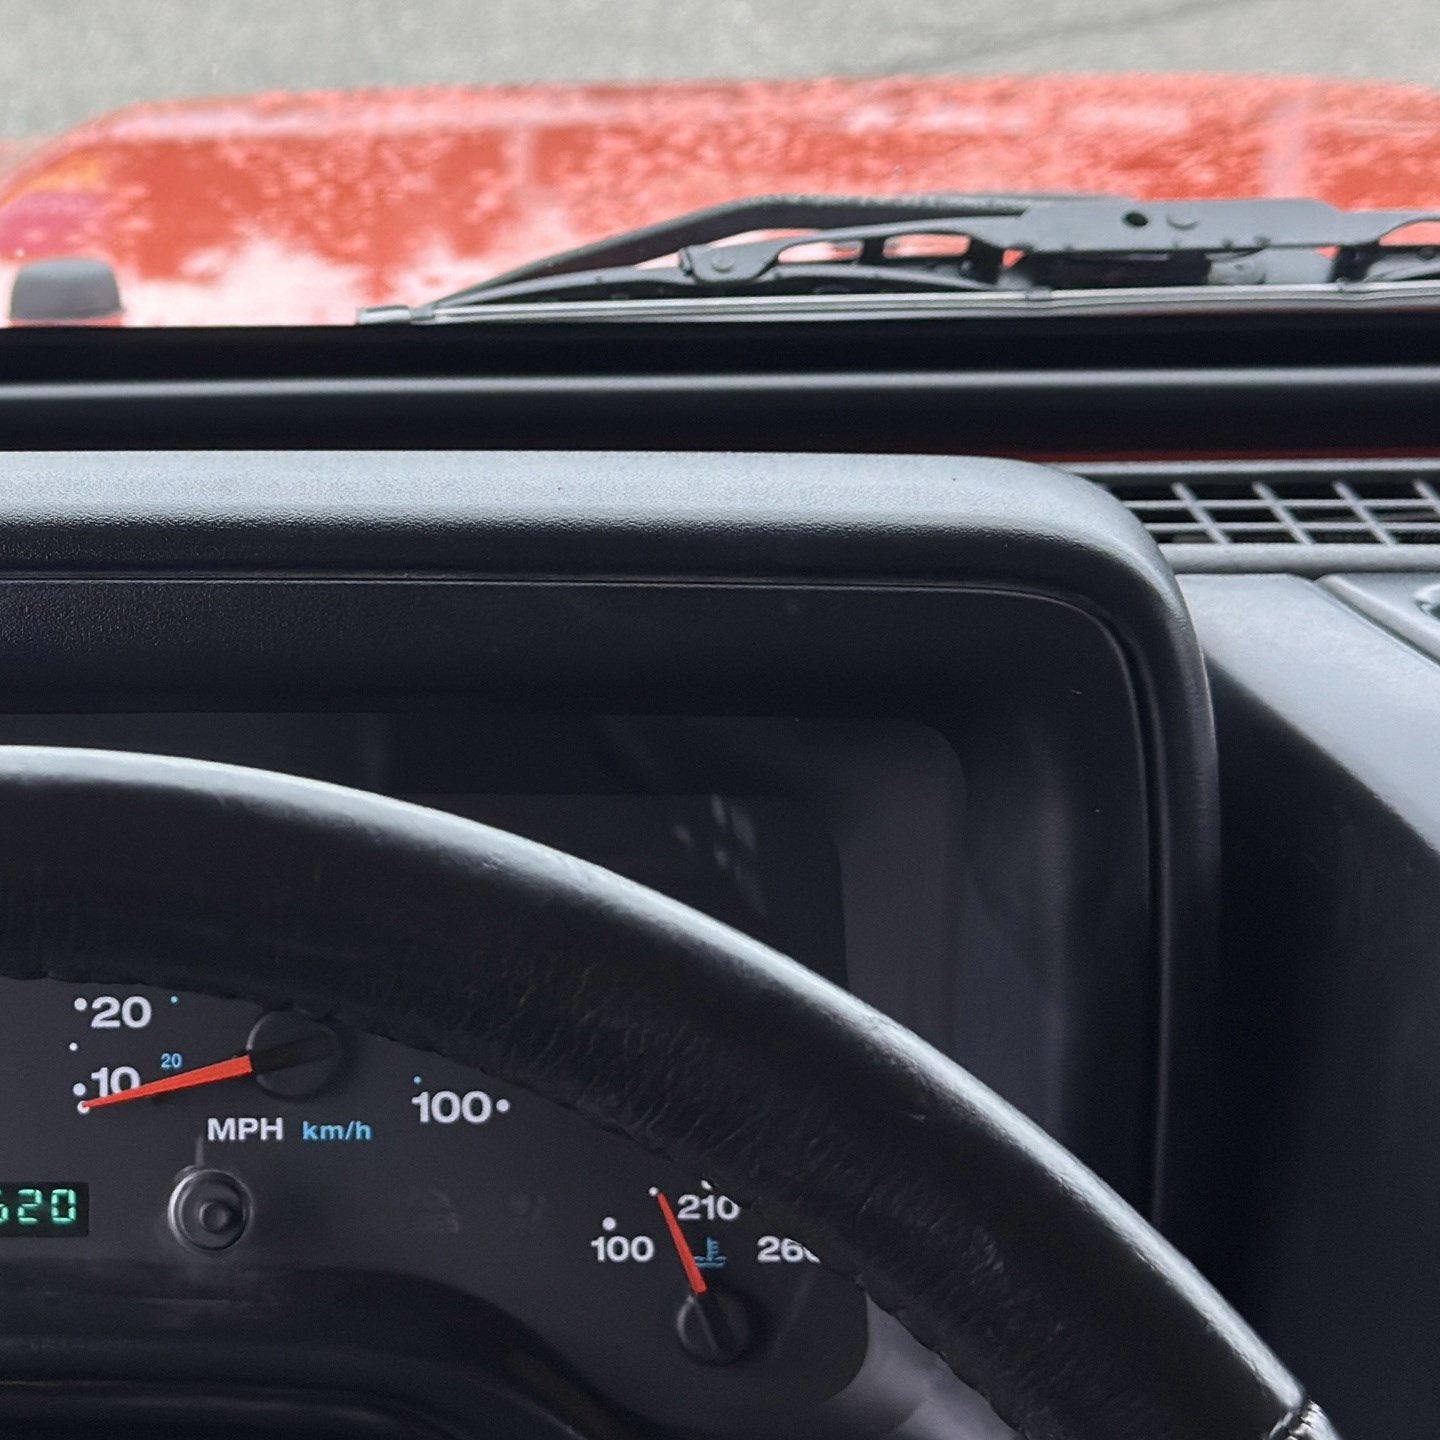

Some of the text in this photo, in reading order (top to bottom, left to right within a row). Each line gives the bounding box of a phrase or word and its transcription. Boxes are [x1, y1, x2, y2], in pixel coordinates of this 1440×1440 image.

[90, 995, 152, 1029] 20
[160, 1052, 183, 1069] 20
[90, 1065, 141, 1098] 10
[412, 1090, 492, 1124] 100
[206, 1116, 373, 1143] MPH km/h
[676, 1193, 742, 1222] 210
[589, 1234, 656, 1263] 100
[756, 1234, 822, 1265] 26
